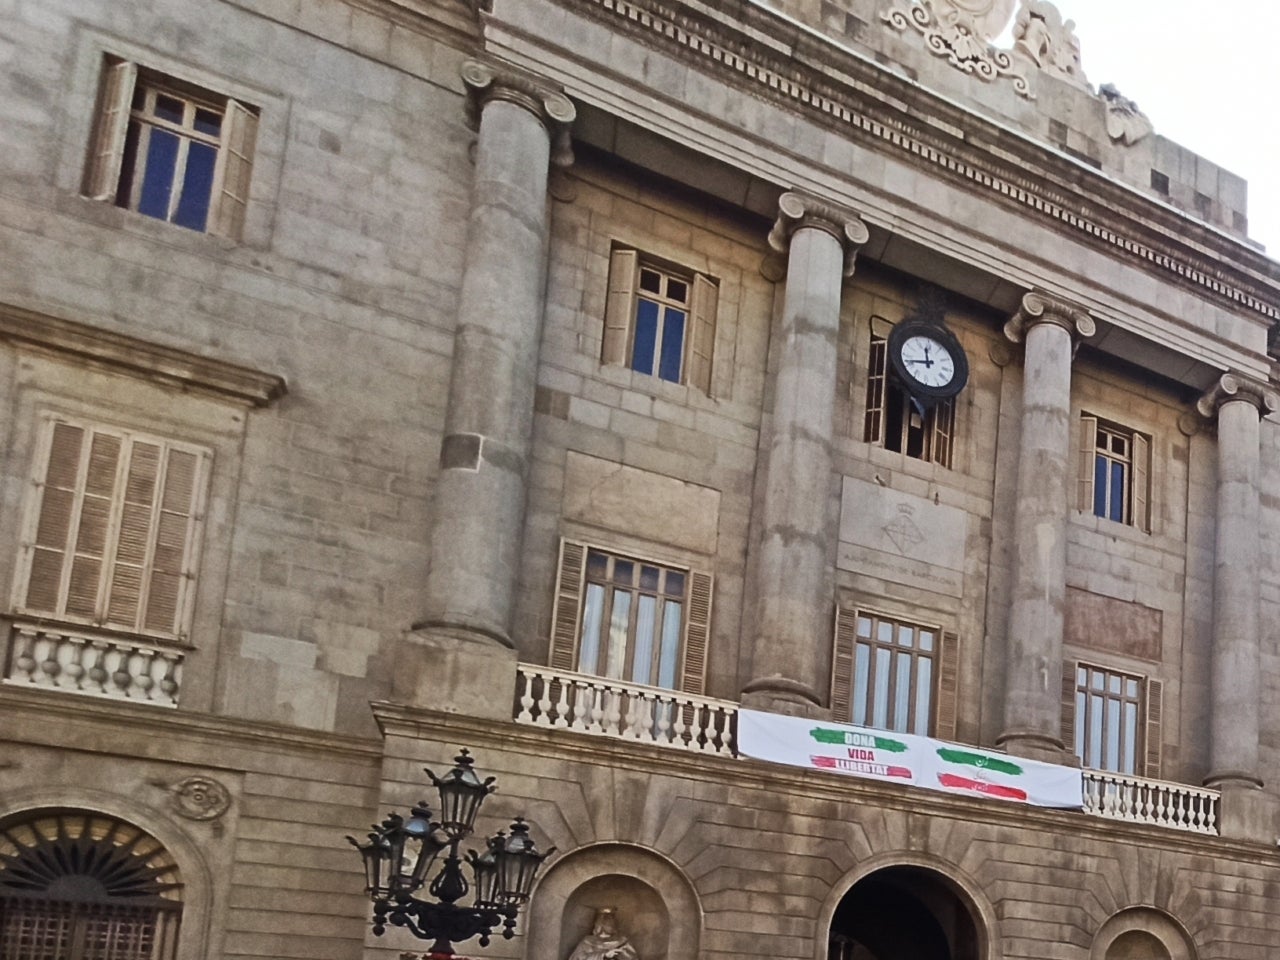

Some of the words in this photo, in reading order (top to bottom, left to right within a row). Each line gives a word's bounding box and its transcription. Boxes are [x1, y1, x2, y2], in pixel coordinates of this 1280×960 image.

[844, 732, 876, 748] DONA
[848, 748, 875, 761] VIDA
[835, 759, 888, 776] LLIBERTAT
